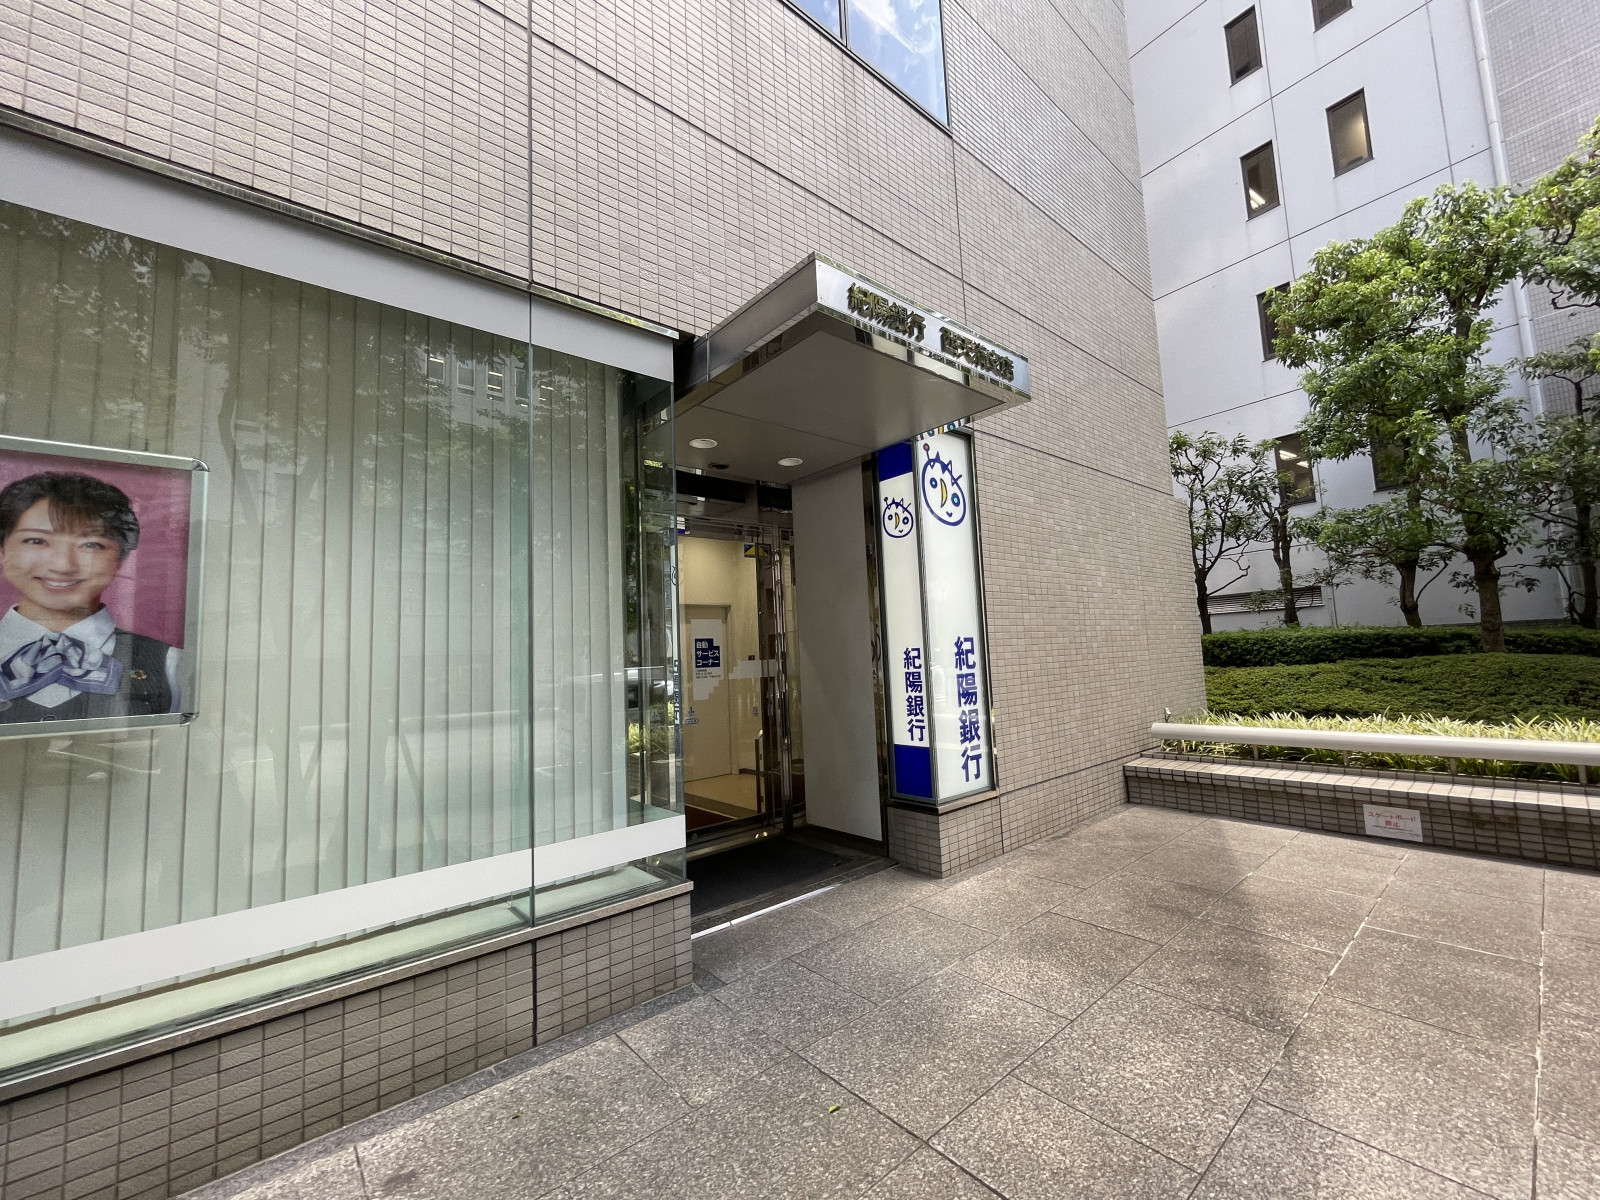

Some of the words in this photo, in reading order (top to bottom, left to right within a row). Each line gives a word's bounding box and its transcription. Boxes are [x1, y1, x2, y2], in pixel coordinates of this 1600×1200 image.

[696, 641, 709, 649] 自動
[903, 647, 926, 742] 紀陽銀行
[954, 636, 982, 782] 紀陽銀行
[1368, 811, 1417, 822] スケートボード
